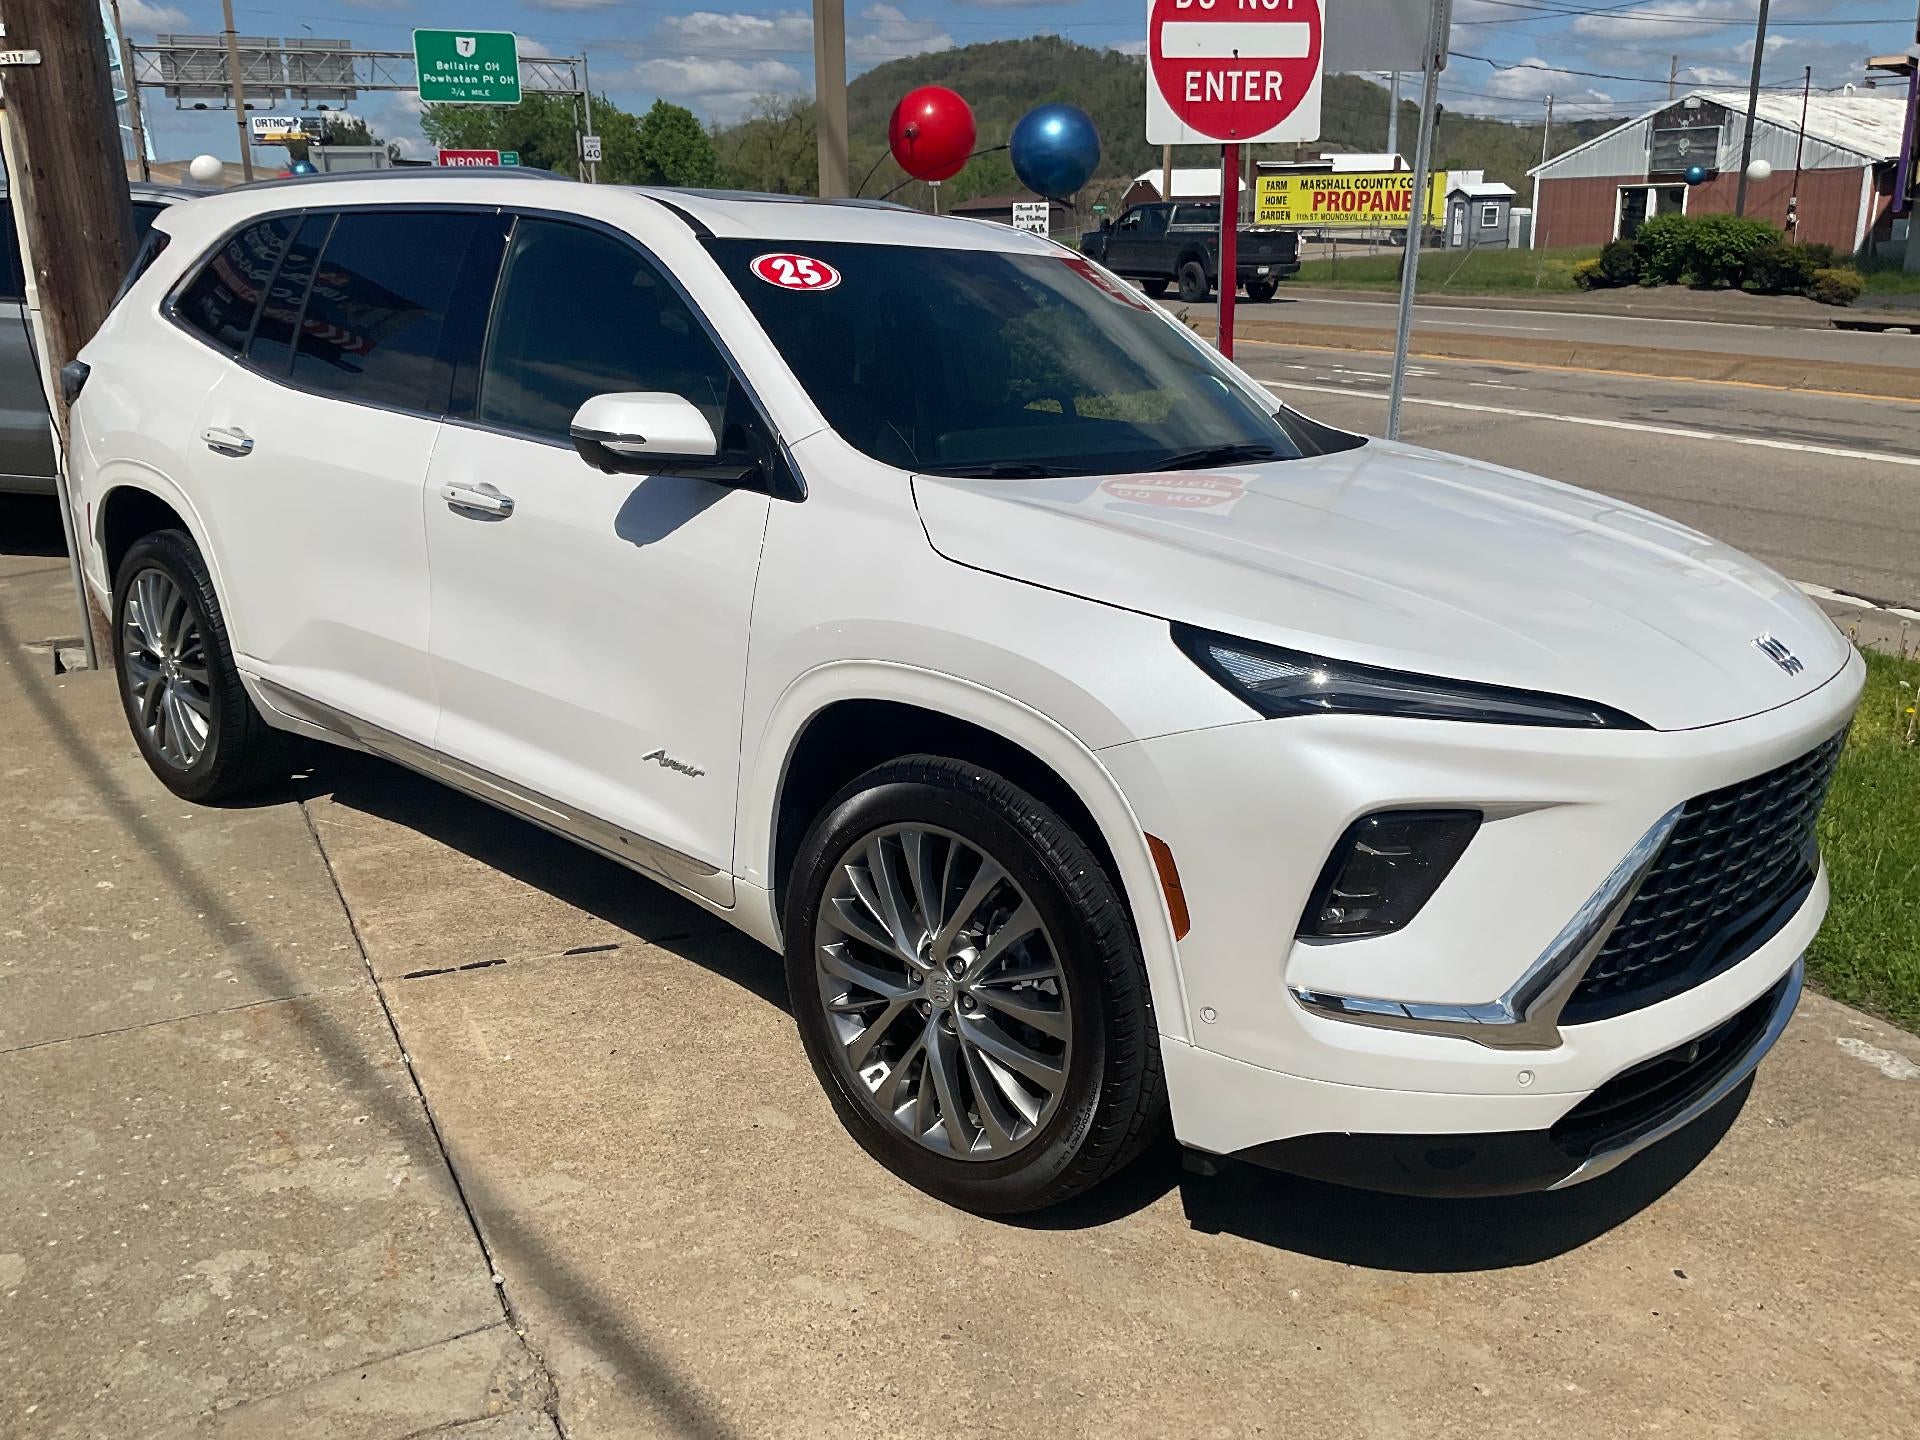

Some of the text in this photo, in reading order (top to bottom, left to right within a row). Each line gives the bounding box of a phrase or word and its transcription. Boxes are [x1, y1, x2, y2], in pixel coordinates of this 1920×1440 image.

[463, 41, 470, 52] 7
[436, 61, 500, 71] Bellaire OH
[423, 74, 514, 85] Powhatan Pt OH
[1185, 71, 1283, 102] ENTER
[451, 88, 491, 97] 3/4 MILE
[255, 118, 286, 128] ORTHO
[585, 149, 600, 159] 40
[446, 157, 493, 166] WRONG
[1266, 180, 1288, 191] FARM
[1300, 179, 1351, 190] MARSHALL
[1354, 178, 1398, 189] COUNTY
[1265, 195, 1288, 205] HOME
[1312, 190, 1413, 212] PROPANE
[1260, 210, 1291, 221] GARDEN
[1296, 213, 1309, 221] 11th
[771, 258, 822, 285] 25
[641, 749, 706, 778] Avenir
